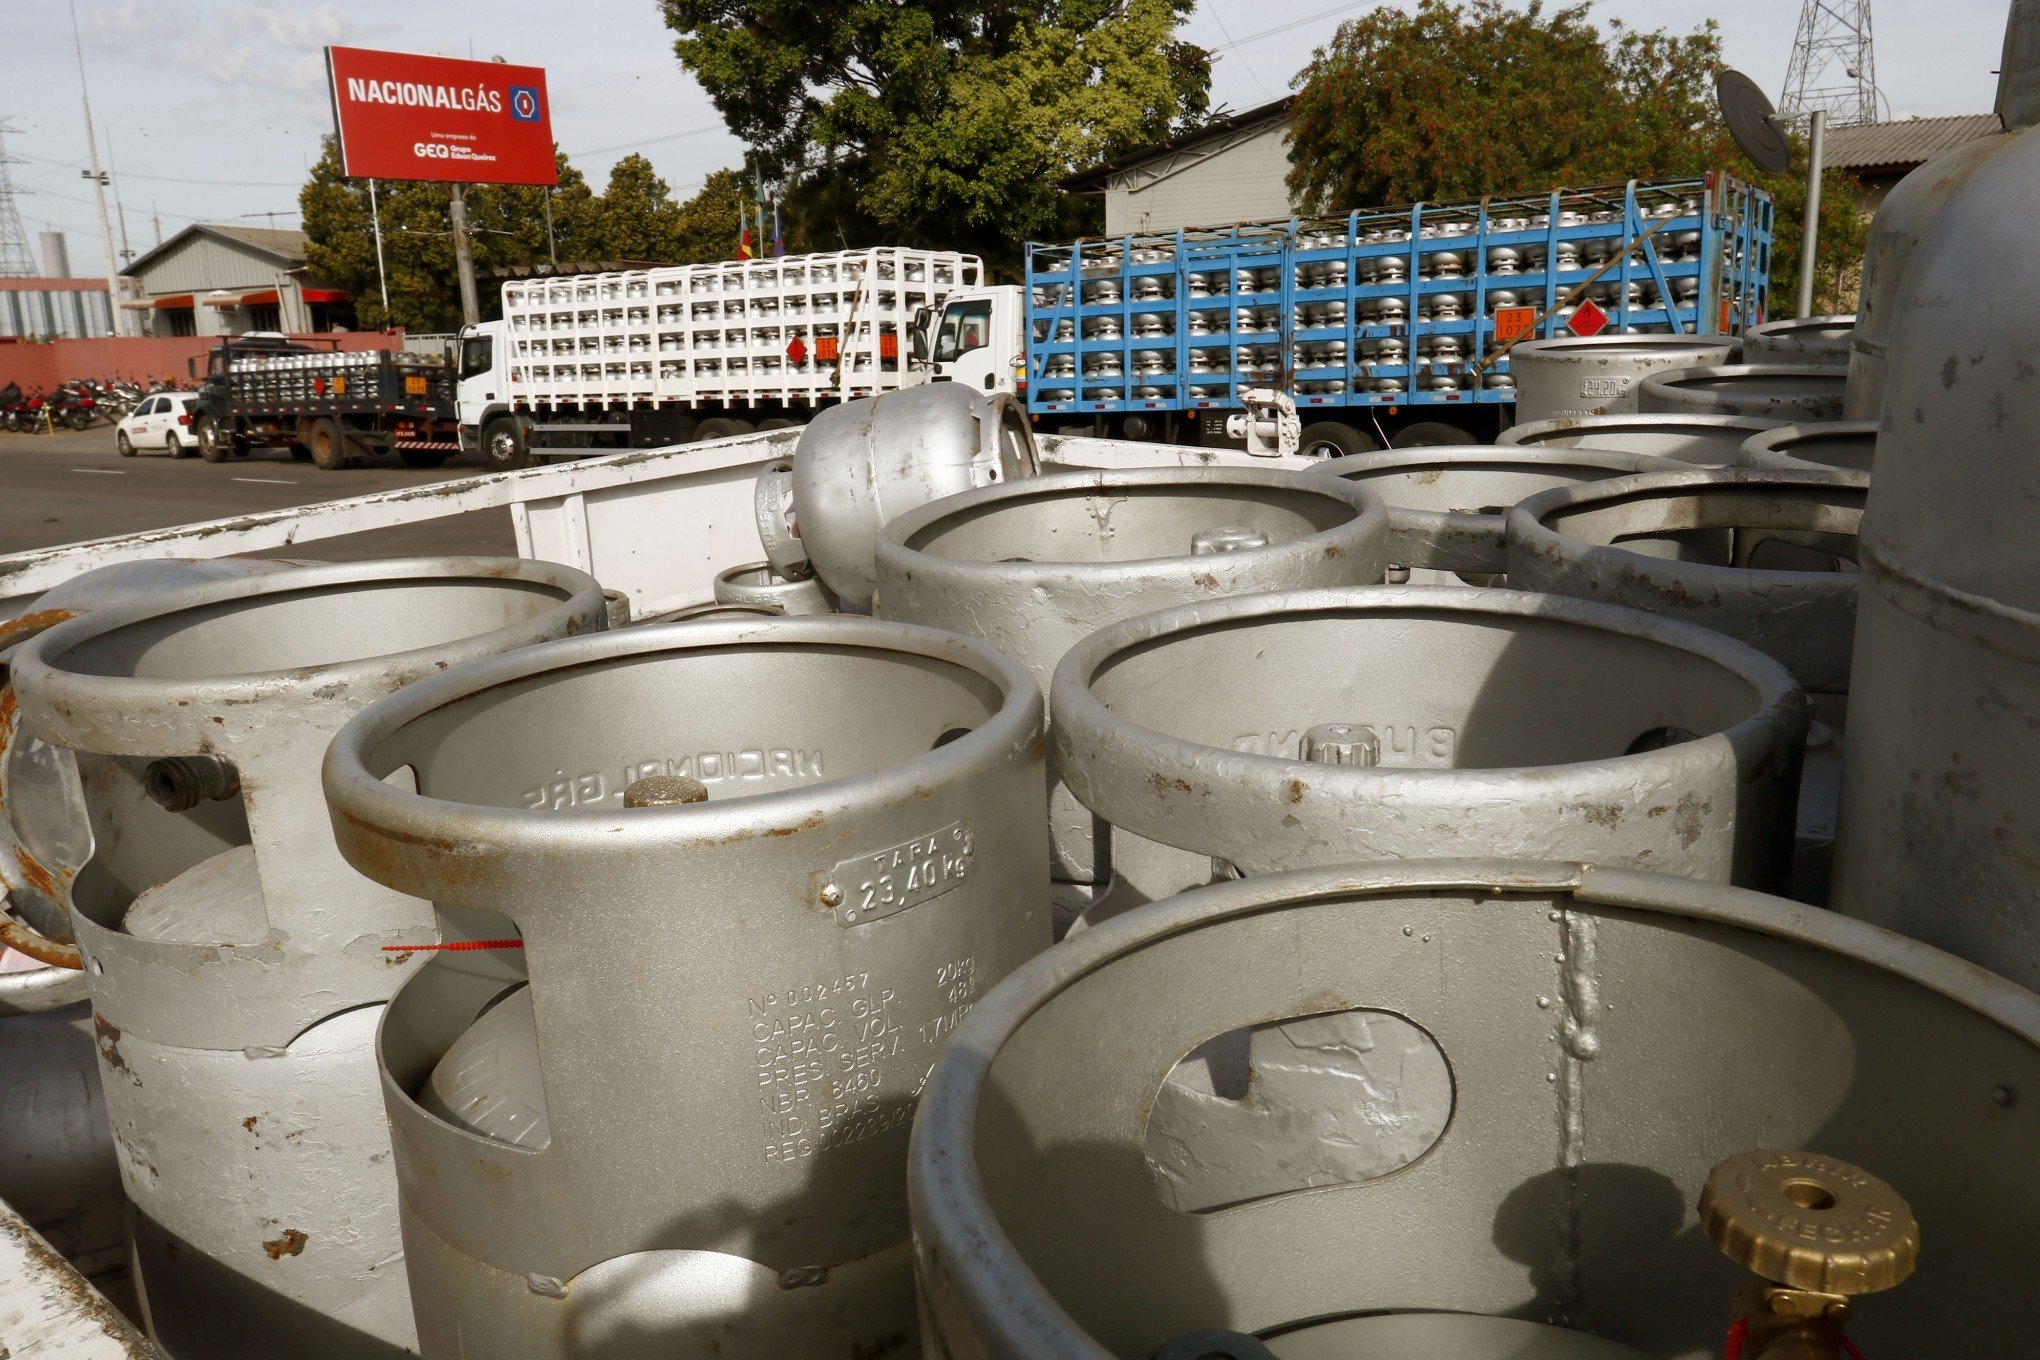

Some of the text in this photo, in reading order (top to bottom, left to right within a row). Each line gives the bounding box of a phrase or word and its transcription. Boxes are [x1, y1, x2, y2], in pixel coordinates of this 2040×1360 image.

[348, 78, 502, 113] NACIONALGÁS
[431, 131, 444, 139] Uma
[414, 142, 449, 158] GEQ
[450, 145, 471, 154] Grupo
[1507, 312, 1522, 322] 23
[822, 340, 831, 348] 23
[884, 337, 892, 345] 23
[818, 350, 836, 358] 1075
[1588, 380, 1616, 397] 24,20
[874, 838, 937, 872] TARA
[861, 859, 936, 911] 23,40
[787, 971, 868, 1007] 002457
[761, 1069, 881, 1117] NBR 8460
